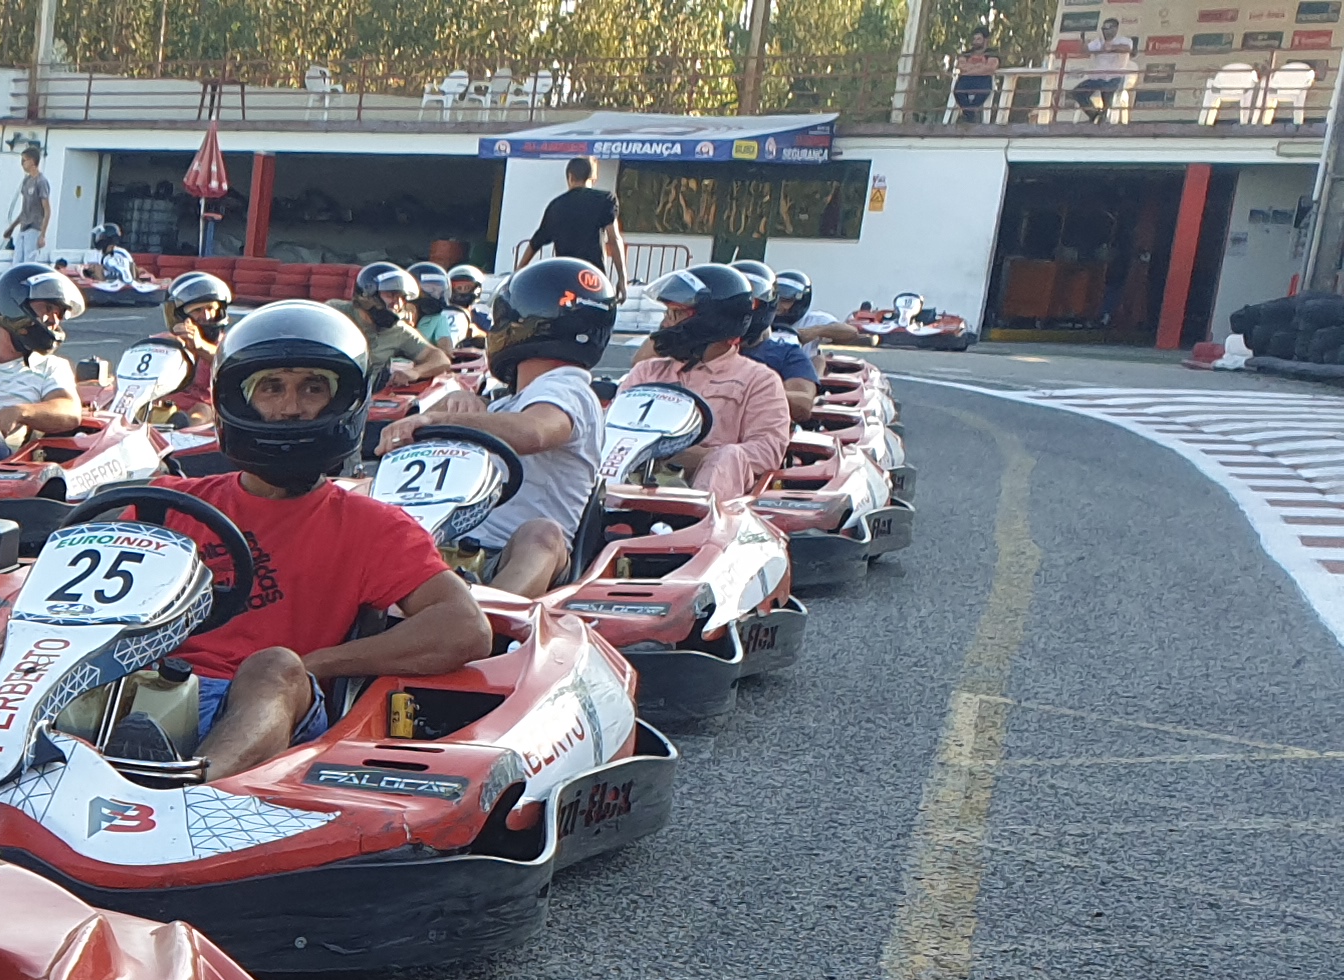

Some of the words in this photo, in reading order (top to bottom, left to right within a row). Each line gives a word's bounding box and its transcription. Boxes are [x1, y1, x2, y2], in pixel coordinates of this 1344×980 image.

[593, 141, 682, 157] SEGURANÇA
[137, 353, 152, 373] 8
[638, 398, 655, 422] 1
[391, 449, 470, 463] EUROINDY
[395, 457, 451, 494] 21
[55, 535, 169, 551] EUROINDY
[44, 548, 146, 605] 25
[318, 769, 463, 798] PALOCAR
